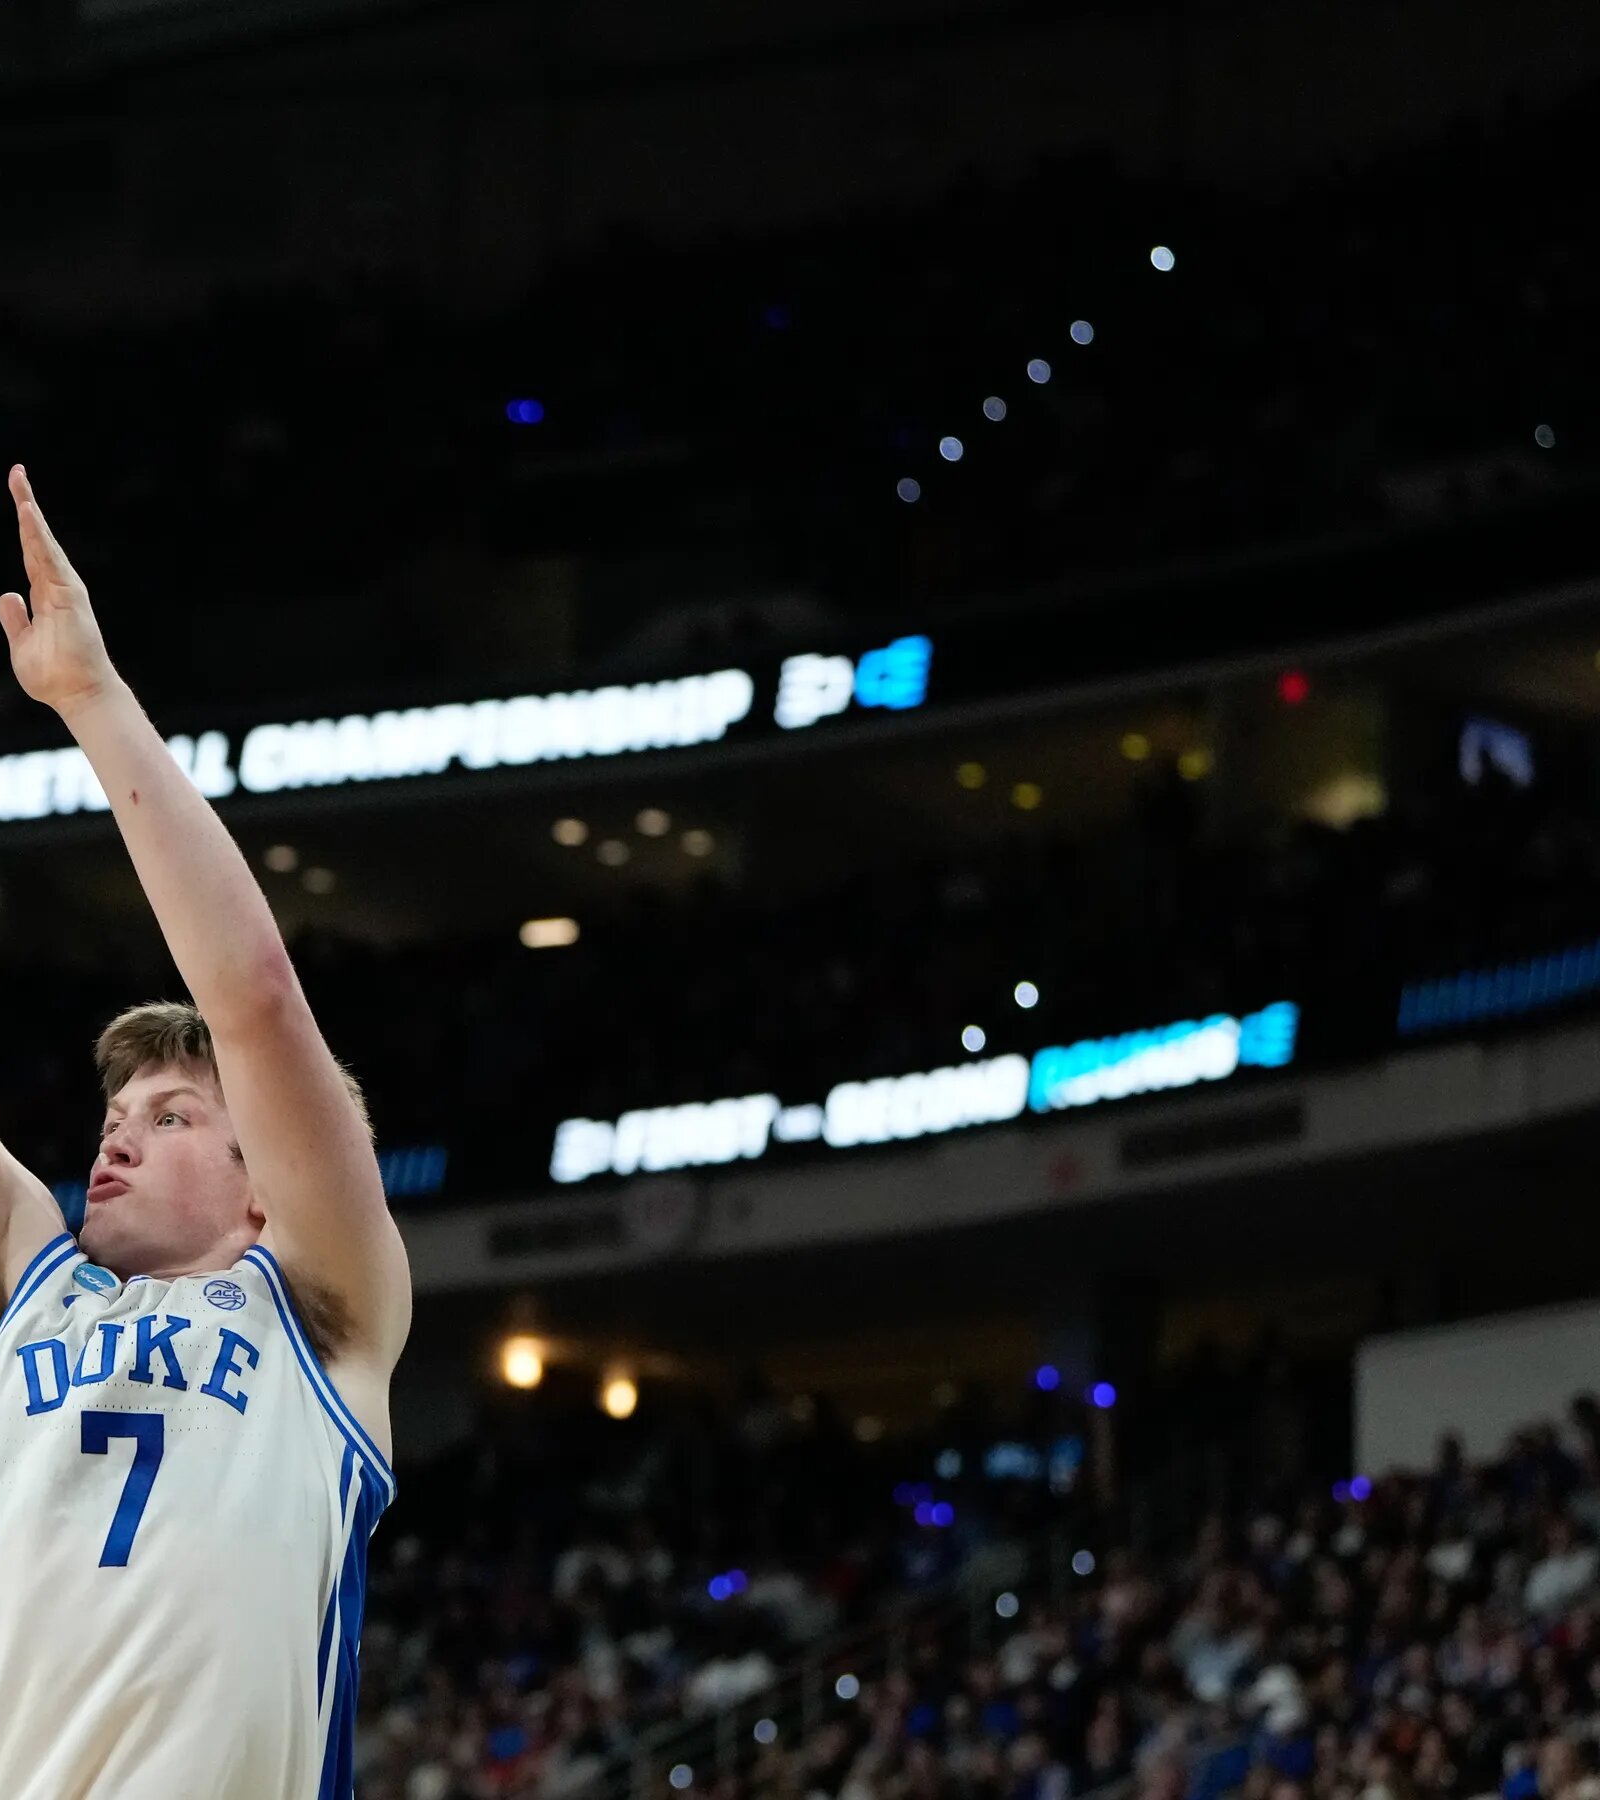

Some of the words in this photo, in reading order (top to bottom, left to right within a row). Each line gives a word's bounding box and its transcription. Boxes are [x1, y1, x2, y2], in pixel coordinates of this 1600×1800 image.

[210, 1289, 242, 1298] ACC
[16, 1314, 260, 1417] DUKE
[80, 1410, 165, 1568] 7
